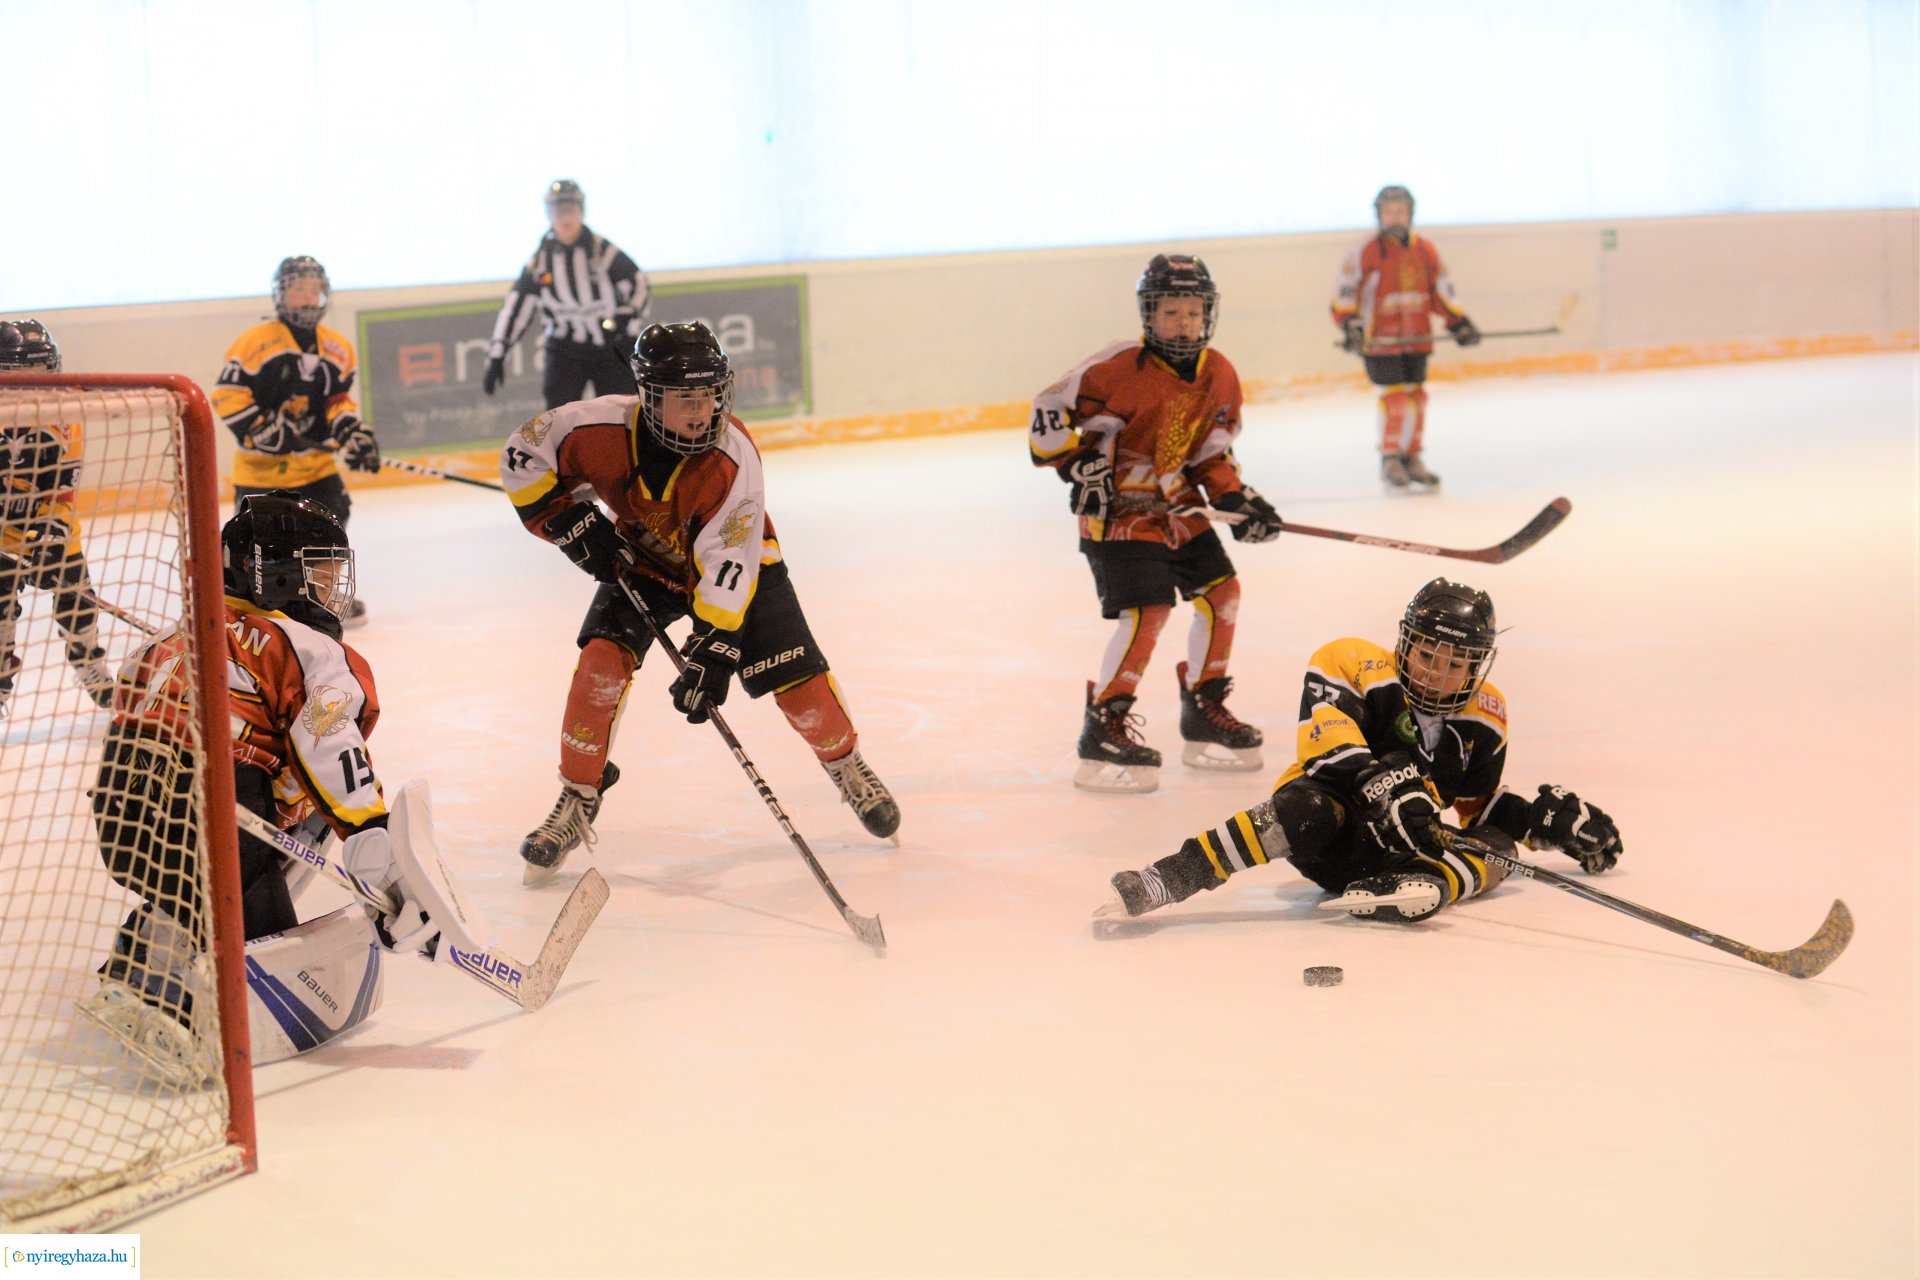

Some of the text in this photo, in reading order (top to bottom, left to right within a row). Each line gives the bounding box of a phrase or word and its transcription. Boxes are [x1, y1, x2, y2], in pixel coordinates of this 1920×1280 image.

[506, 446, 533, 473] 17
[553, 511, 598, 548] AUER
[714, 559, 744, 592] 17
[338, 746, 375, 794] 15
[1362, 762, 1421, 804] Reebok
